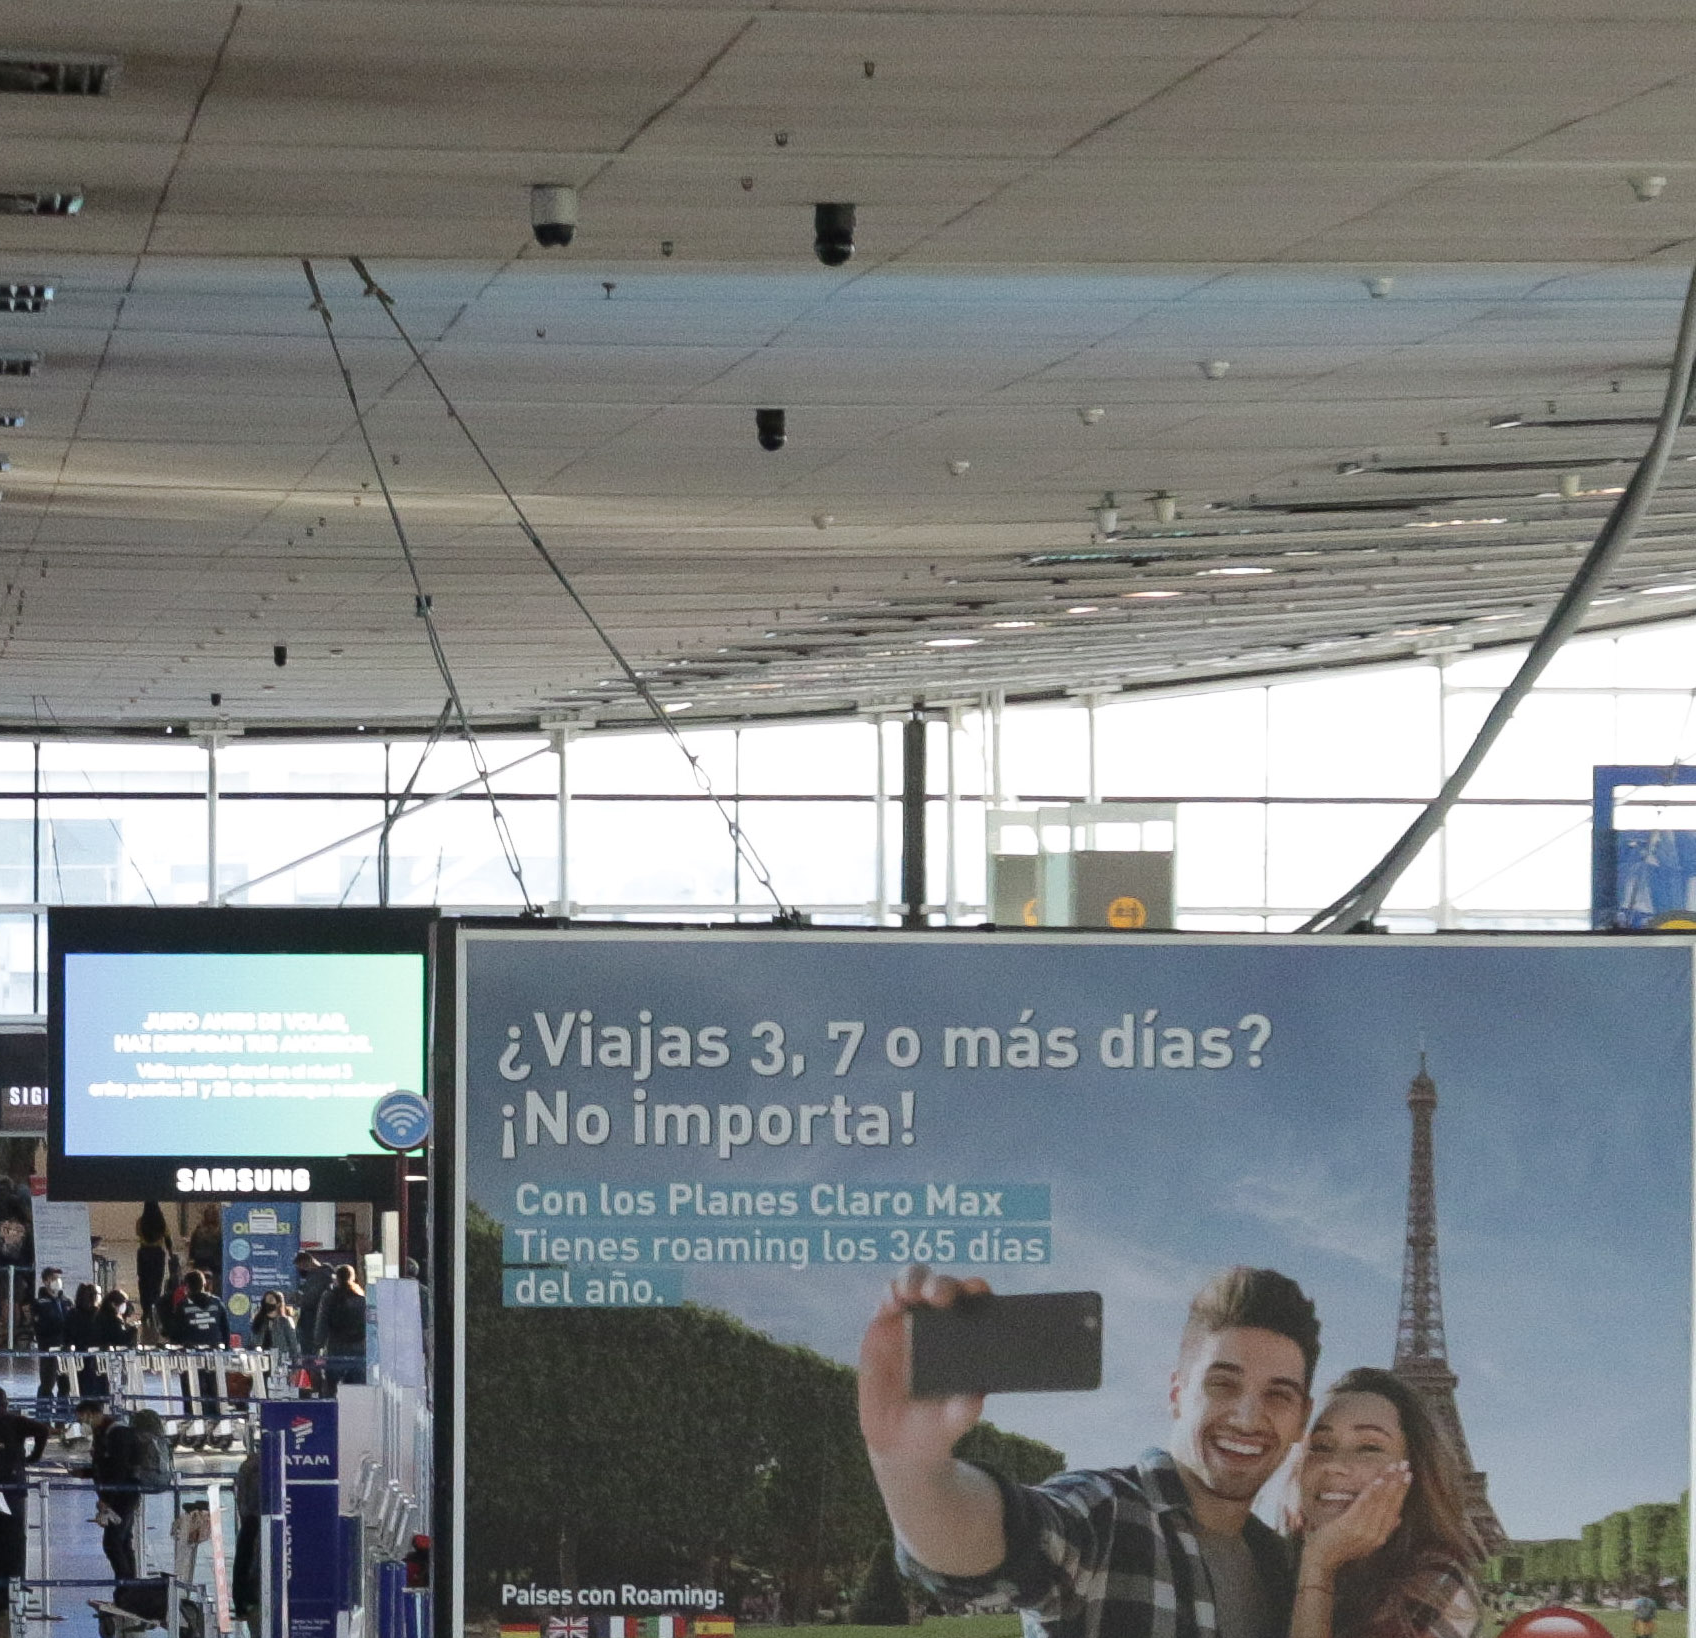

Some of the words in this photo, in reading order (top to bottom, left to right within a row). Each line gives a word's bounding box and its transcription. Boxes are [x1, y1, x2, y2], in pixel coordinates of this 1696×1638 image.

[498, 1009, 733, 1083] ¿Viajas
[749, 1021, 809, 1079] 3,
[826, 1020, 868, 1077] 7
[885, 1030, 922, 1070] o
[943, 1012, 1080, 1071] más
[1098, 1009, 1274, 1071] días?
[500, 1090, 612, 1160] ¡No
[632, 1089, 918, 1160] importa!
[175, 1167, 311, 1193] SAMSUNG
[515, 1183, 589, 1218] Con
[600, 1182, 659, 1219] los
[667, 1182, 800, 1219] Planes
[808, 1182, 915, 1219] Claro
[924, 1185, 1005, 1218] Max
[515, 1227, 640, 1264] Tienes
[650, 1230, 810, 1271] roaming
[822, 1228, 877, 1264] los
[889, 1230, 956, 1265] 365
[966, 1227, 1047, 1265] días
[514, 1271, 574, 1307] del
[584, 1269, 666, 1307] año.
[284, 1454, 331, 1466] ATAM
[501, 1583, 573, 1606] Países
[577, 1588, 616, 1606] con
[621, 1584, 726, 1610] Roaming:
